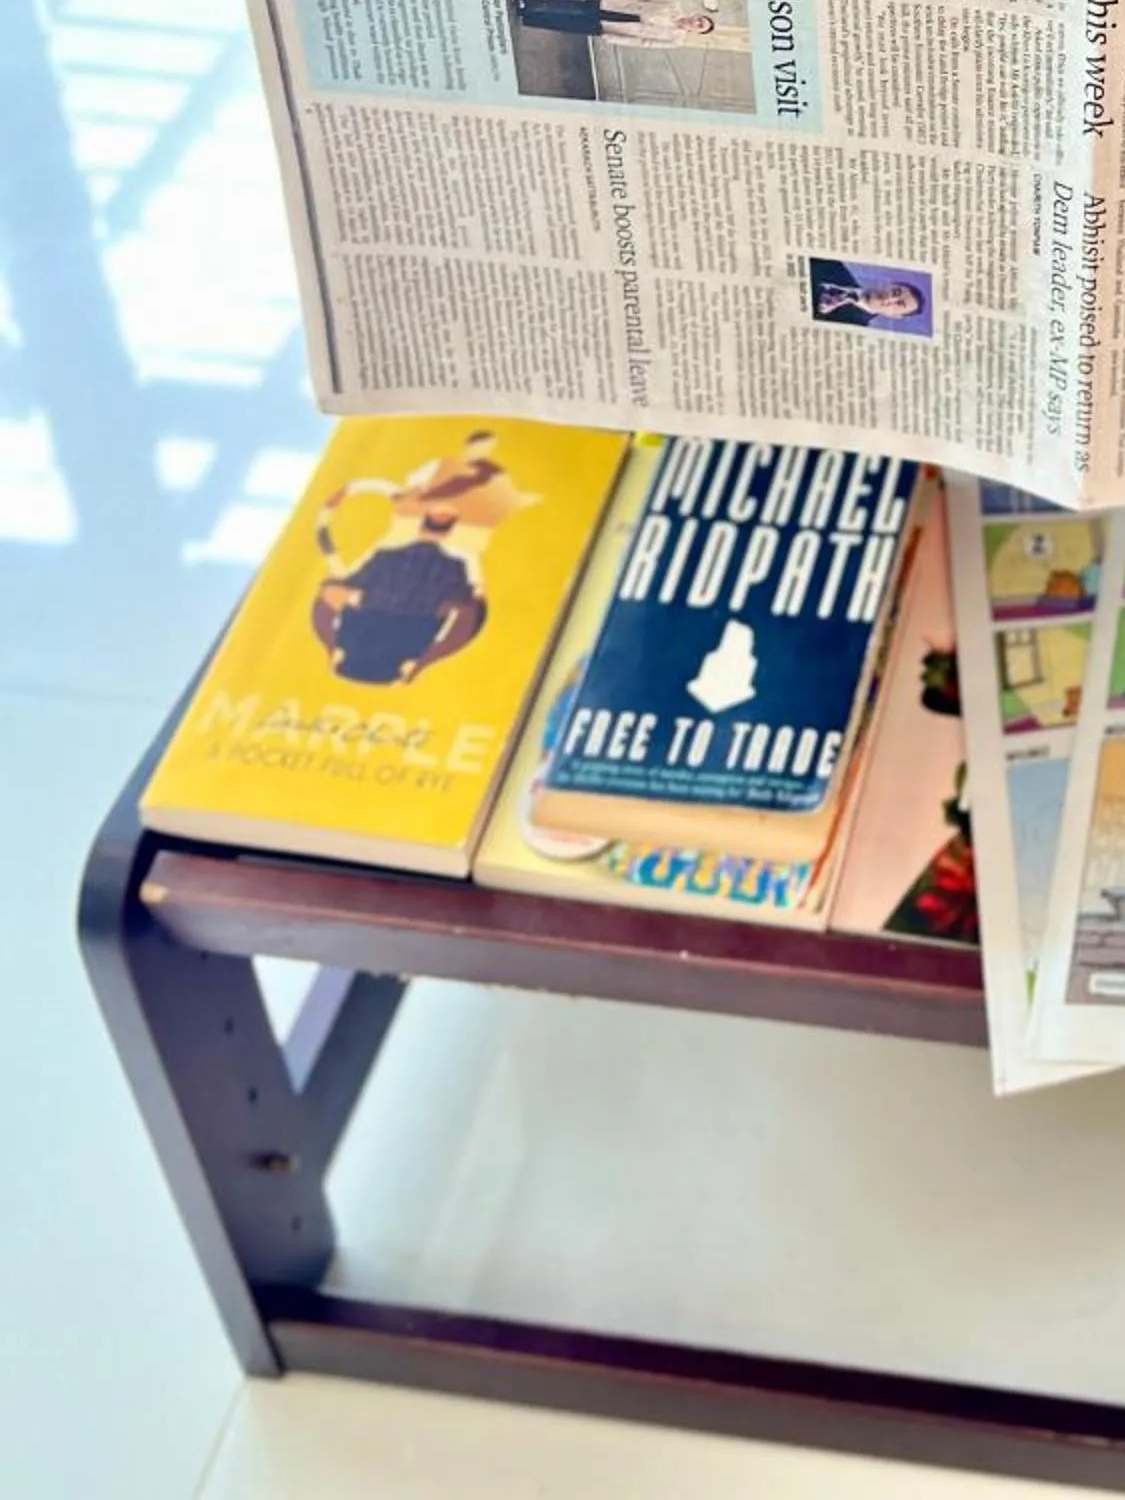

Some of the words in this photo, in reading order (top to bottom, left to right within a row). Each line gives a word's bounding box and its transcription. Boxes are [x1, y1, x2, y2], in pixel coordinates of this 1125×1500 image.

[773, 59, 808, 118] visit
[1083, 55, 1114, 139] week
[603, 129, 628, 199] Senate
[612, 204, 637, 266] boosts
[1052, 180, 1074, 236] Dem
[1081, 191, 1106, 271] Abhisit
[1049, 239, 1072, 313] leader,
[1076, 274, 1101, 347] poised
[615, 269, 650, 354] parental
[628, 359, 652, 408] leave
[1049, 319, 1069, 390] ex-MP
[1078, 354, 1097, 375] to
[1041, 390, 1064, 437] says
[1074, 380, 1095, 446] return
[652, 434, 905, 533] MICHAEL
[1074, 450, 1092, 473] as
[619, 513, 896, 622] RIDPATH
[197, 689, 494, 773] MARPLE
[564, 708, 657, 762] FREE
[667, 717, 714, 768] TO
[726, 721, 844, 779] TRADE
[374, 762, 405, 786] OF
